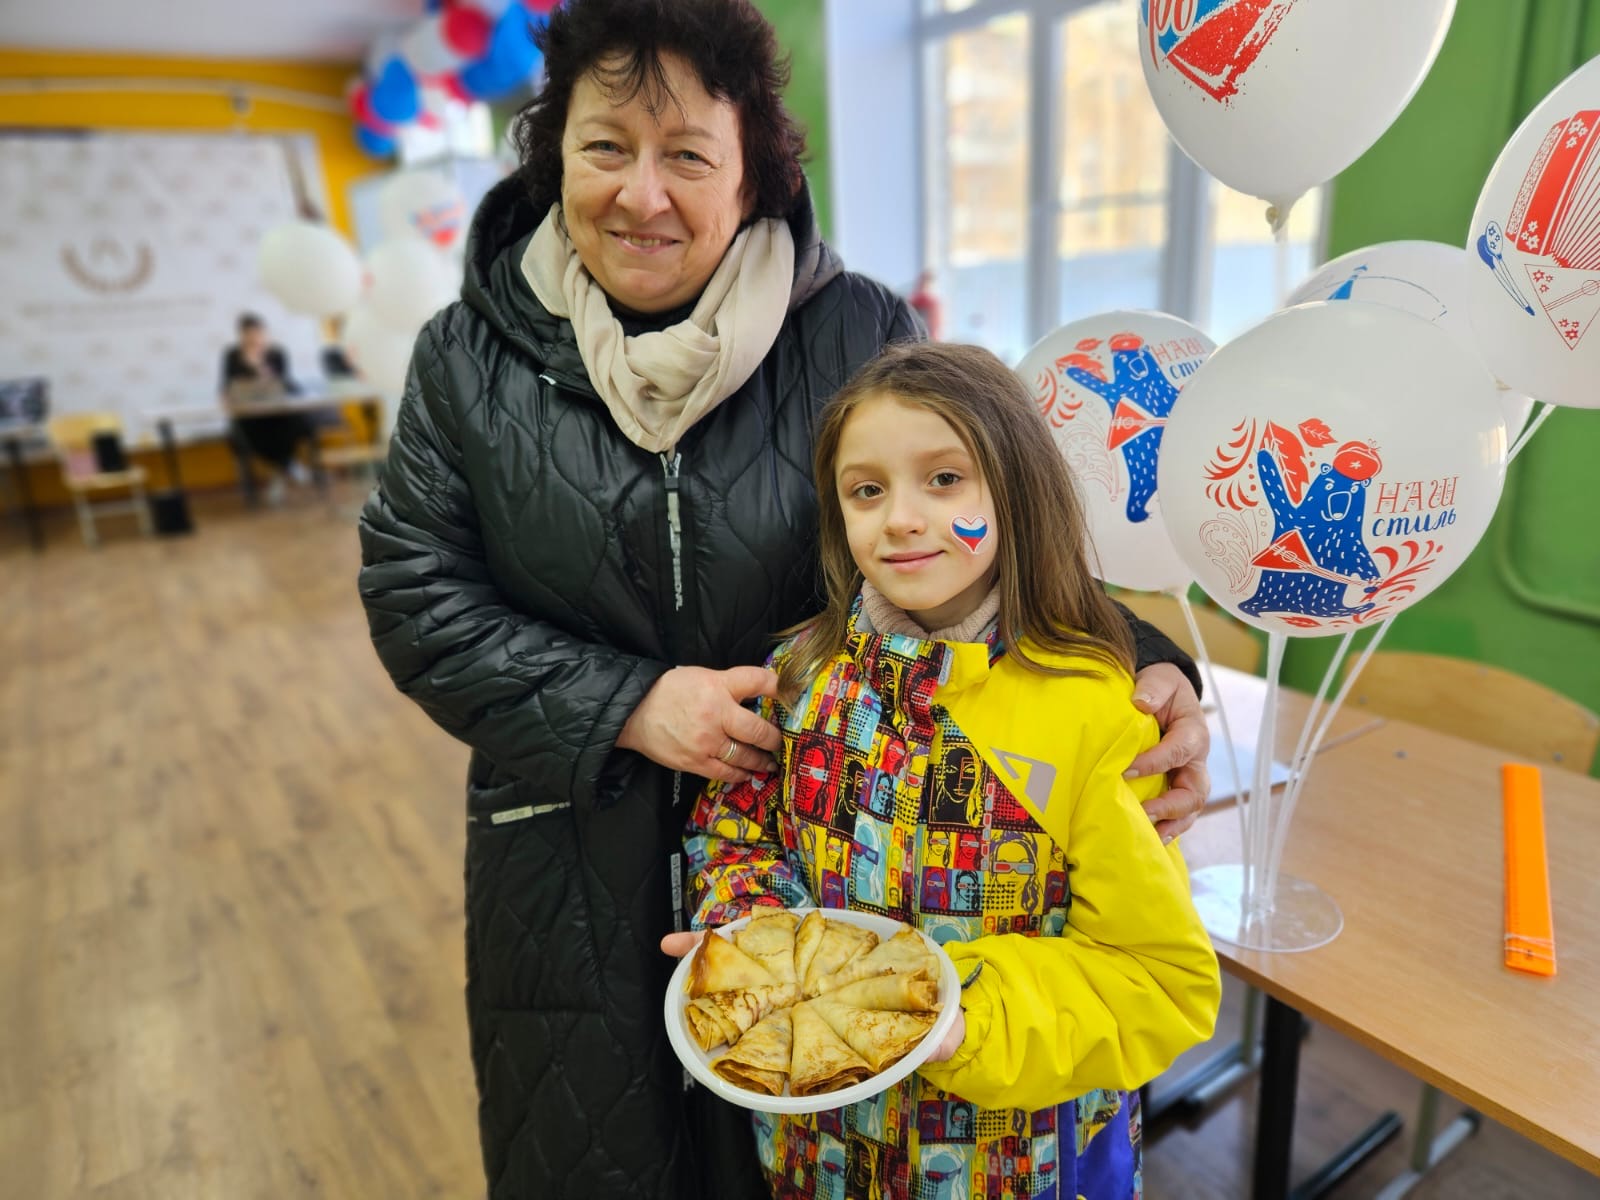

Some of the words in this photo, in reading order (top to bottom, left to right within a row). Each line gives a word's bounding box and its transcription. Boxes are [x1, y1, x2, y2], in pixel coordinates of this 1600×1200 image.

[1151, 338, 1206, 365] НАШ
[1374, 476, 1460, 514] НАШ
[1372, 508, 1457, 537] стиль
